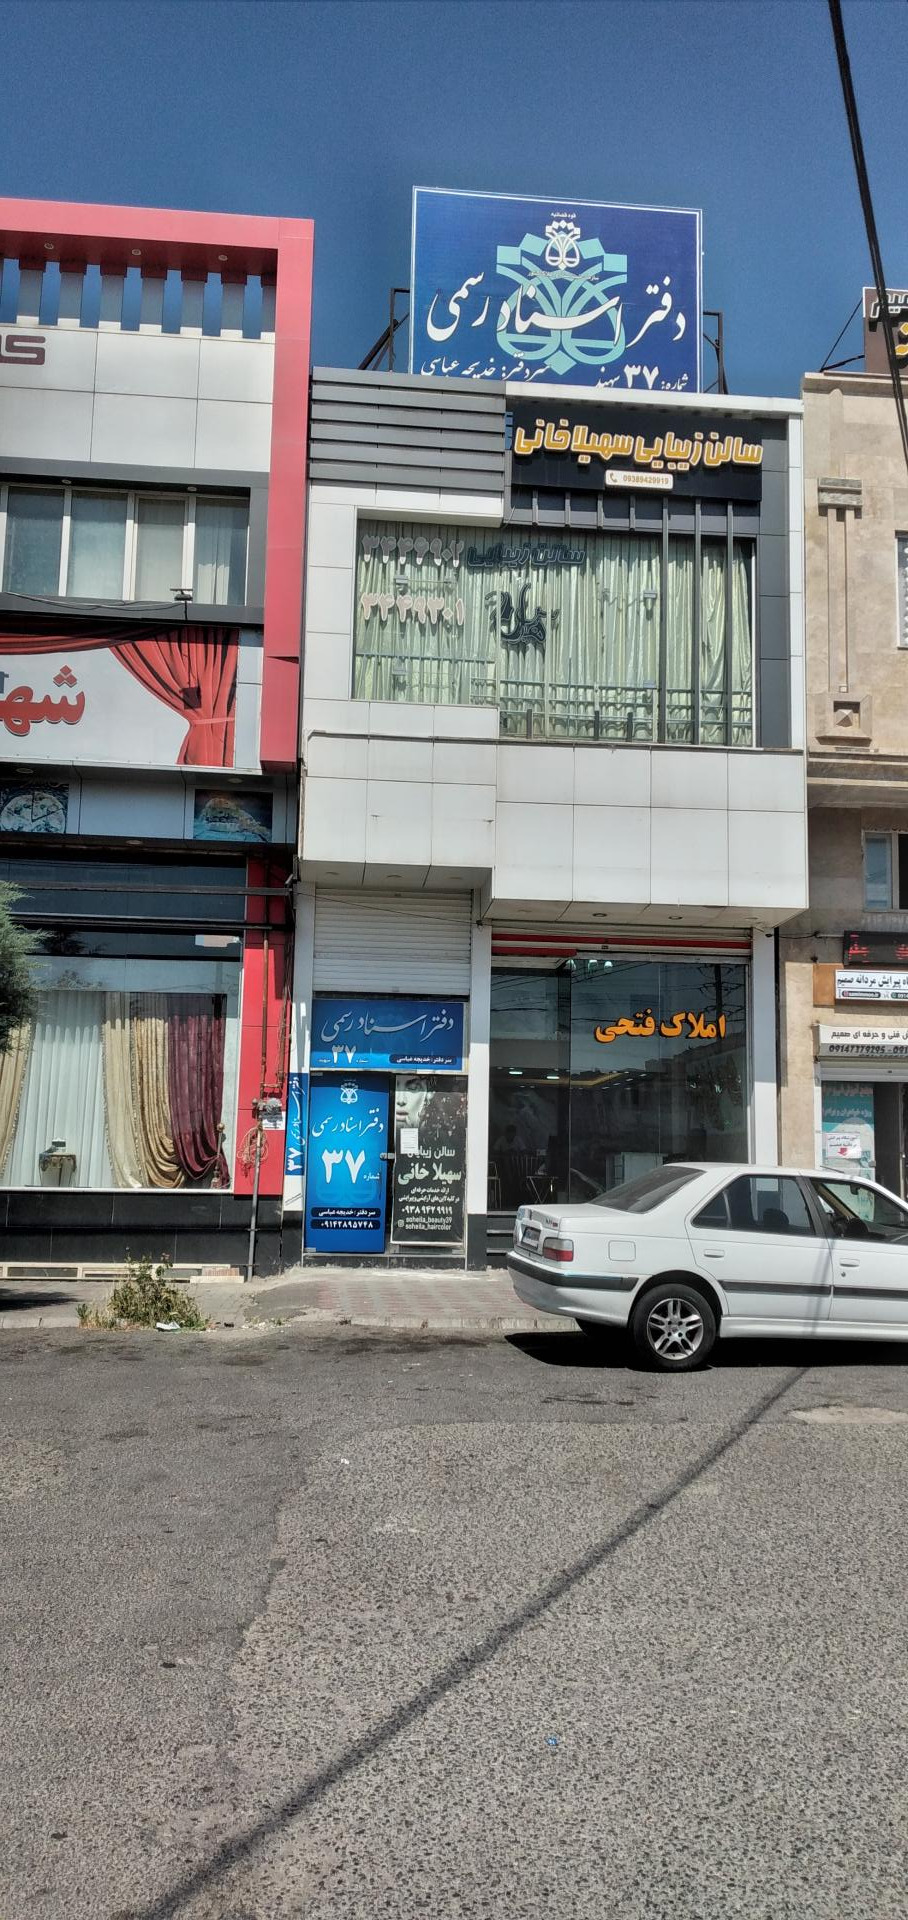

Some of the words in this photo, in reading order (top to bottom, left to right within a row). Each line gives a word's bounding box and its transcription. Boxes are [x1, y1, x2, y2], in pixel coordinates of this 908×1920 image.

[426, 272, 490, 342] رسمی
[497, 283, 623, 347] اسناد
[626, 275, 686, 348] دفتر
[420, 356, 460, 378] عباسی
[623, 364, 660, 390] ۳۷
[514, 418, 572, 455] خانی
[571, 425, 634, 465] سهیلا
[704, 432, 763, 467] سالن
[634, 432, 704, 471] زیبایی
[467, 542, 531, 568] زیبایی
[531, 542, 586, 566] سالن
[0, 664, 86, 736] شه
[320, 1011, 354, 1043] رسمی
[357, 1009, 427, 1037] اسناد
[420, 1008, 454, 1043] دفتر
[594, 1008, 657, 1044] فتحی
[660, 1011, 727, 1040] املاک
[331, 1045, 357, 1064] ۳۷
[311, 1116, 339, 1137] رسمی
[340, 1116, 362, 1133] اسناد
[358, 1107, 384, 1137] دفتر
[287, 1147, 303, 1171] ۳۷
[321, 1148, 366, 1184] ۳۷
[434, 1146, 455, 1159] سالن
[363, 1172, 380, 1181] شماره
[397, 1162, 429, 1185] خانی
[432, 1162, 462, 1184] سهیلا
[318, 1208, 336, 1216] عباسی
[401, 1205, 421, 1214] ۰۹۳۸
[421, 1205, 436, 1214] ۹۴۲
[436, 1206, 453, 1215] ۹۹۱۹
